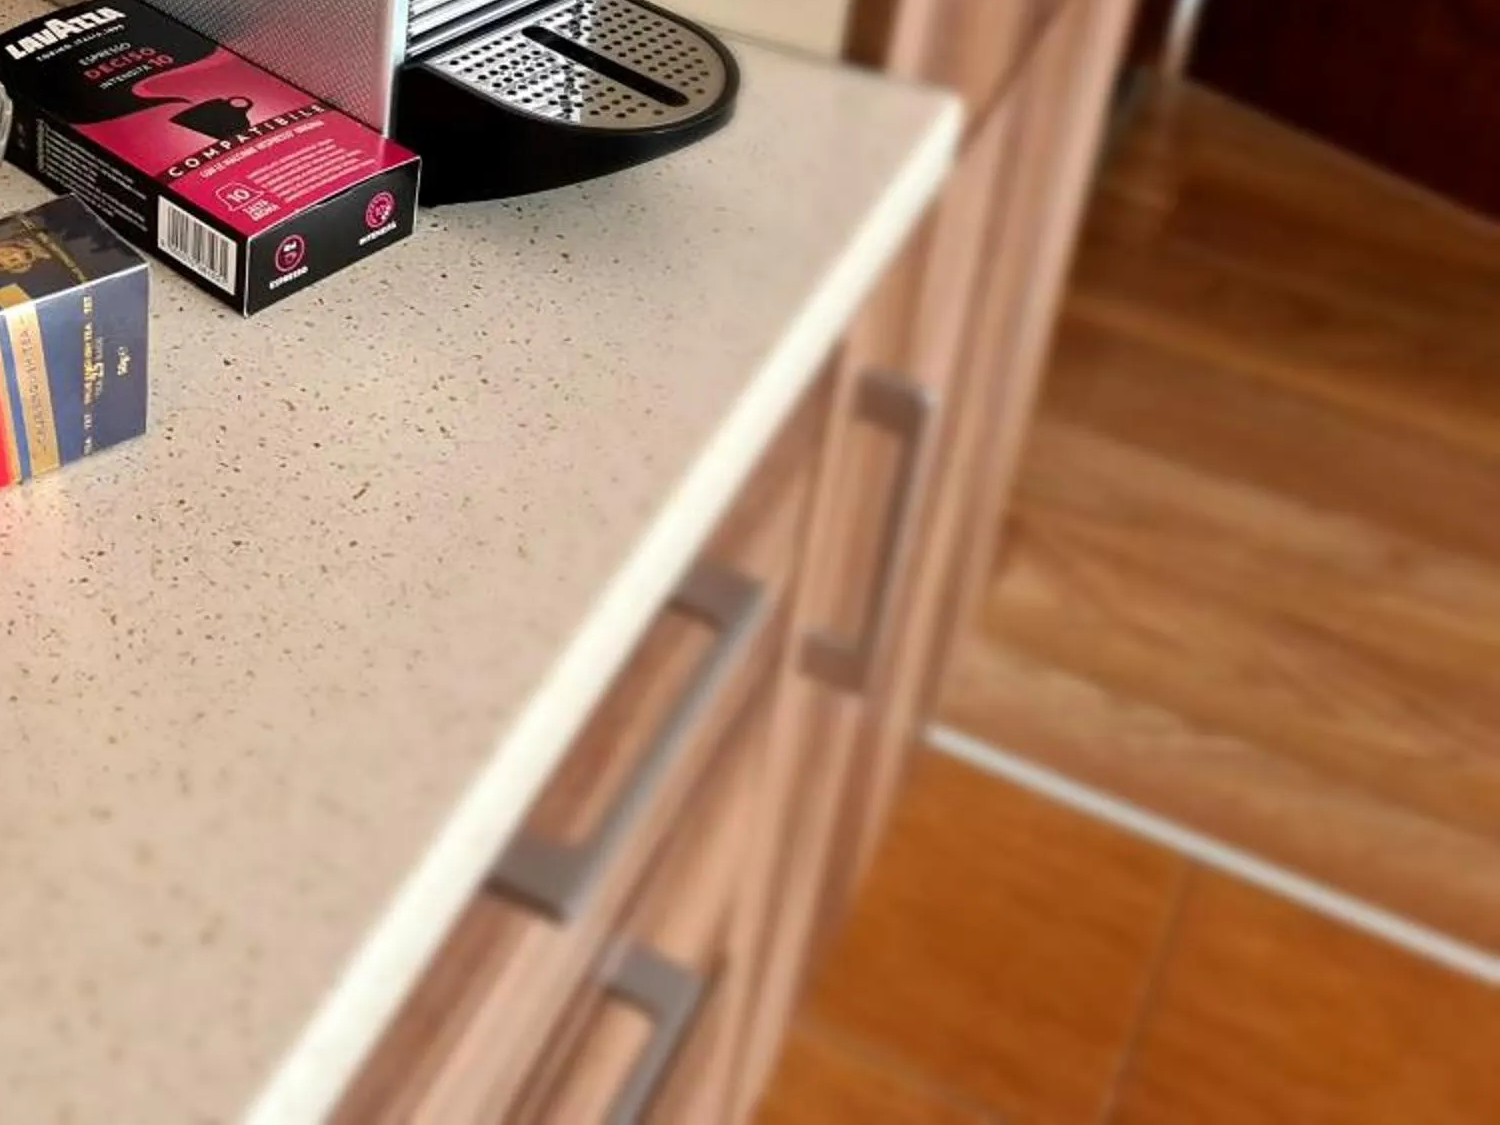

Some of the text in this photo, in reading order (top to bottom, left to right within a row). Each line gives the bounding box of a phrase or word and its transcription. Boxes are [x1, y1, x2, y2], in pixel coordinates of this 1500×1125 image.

[4, 6, 128, 61] LAVAZZA
[83, 46, 157, 81] DECISO
[148, 53, 175, 68] 10
[168, 103, 326, 178] COMPATIBILE
[226, 188, 251, 204] 10
